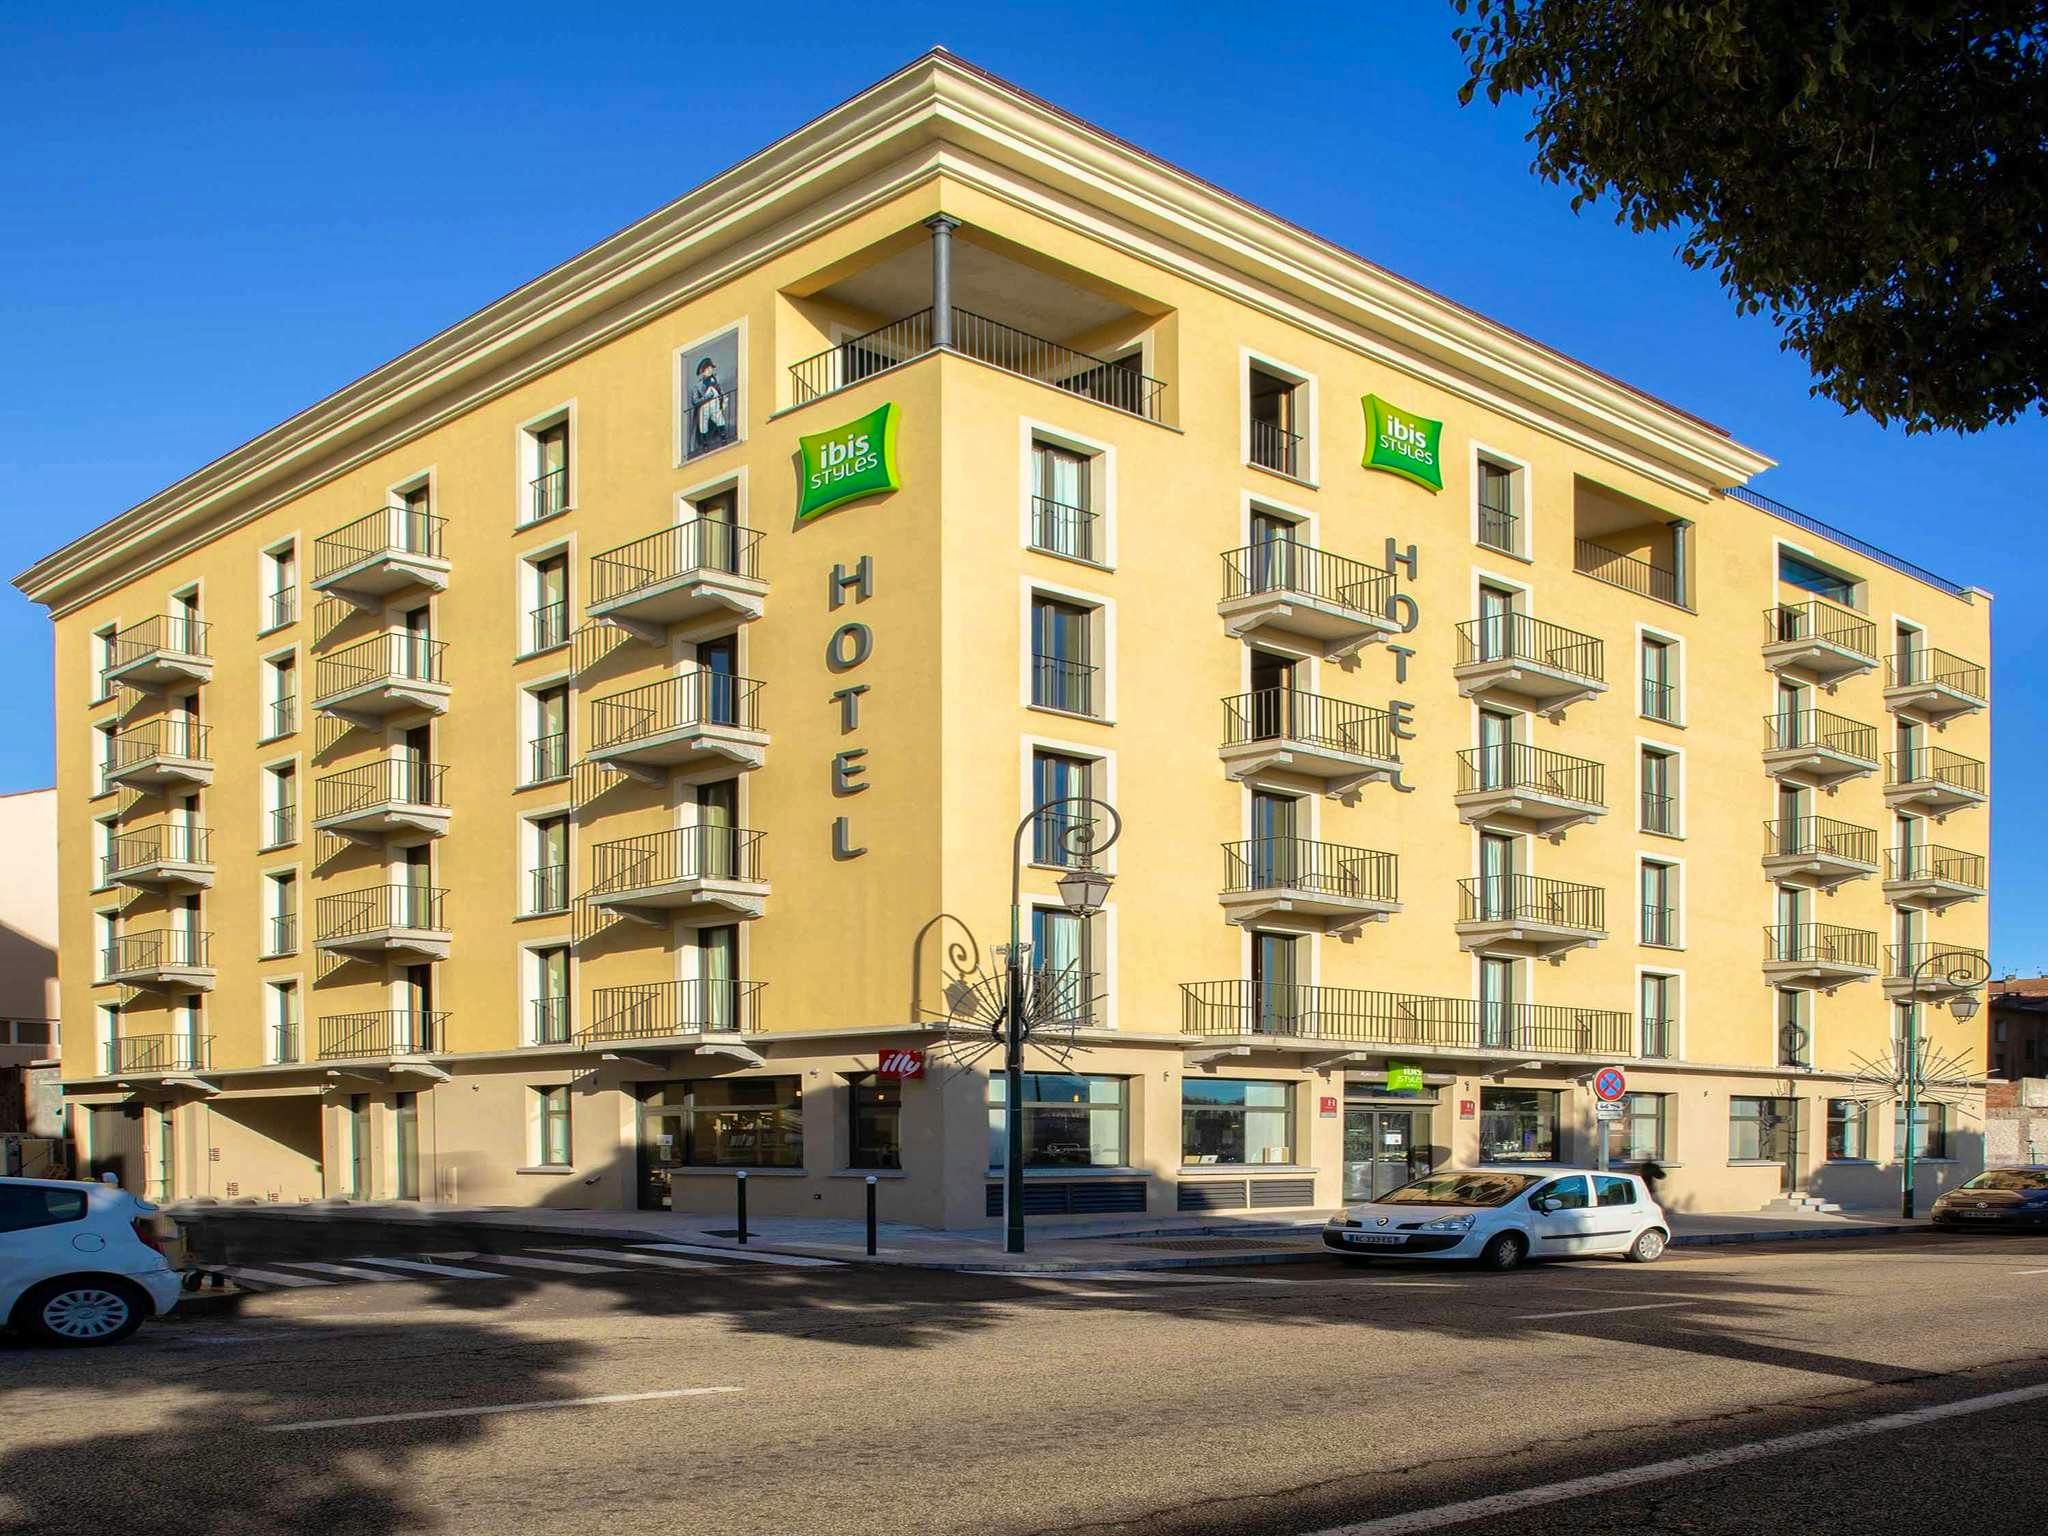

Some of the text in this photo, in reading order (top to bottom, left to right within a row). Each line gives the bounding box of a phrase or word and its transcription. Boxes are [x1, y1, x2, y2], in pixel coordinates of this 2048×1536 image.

[1387, 415, 1427, 448] ibis
[820, 434, 870, 469] ibis
[1385, 537, 1418, 793] HOTEL
[826, 555, 873, 862] HOTEL
[881, 1053, 920, 1077] illy
